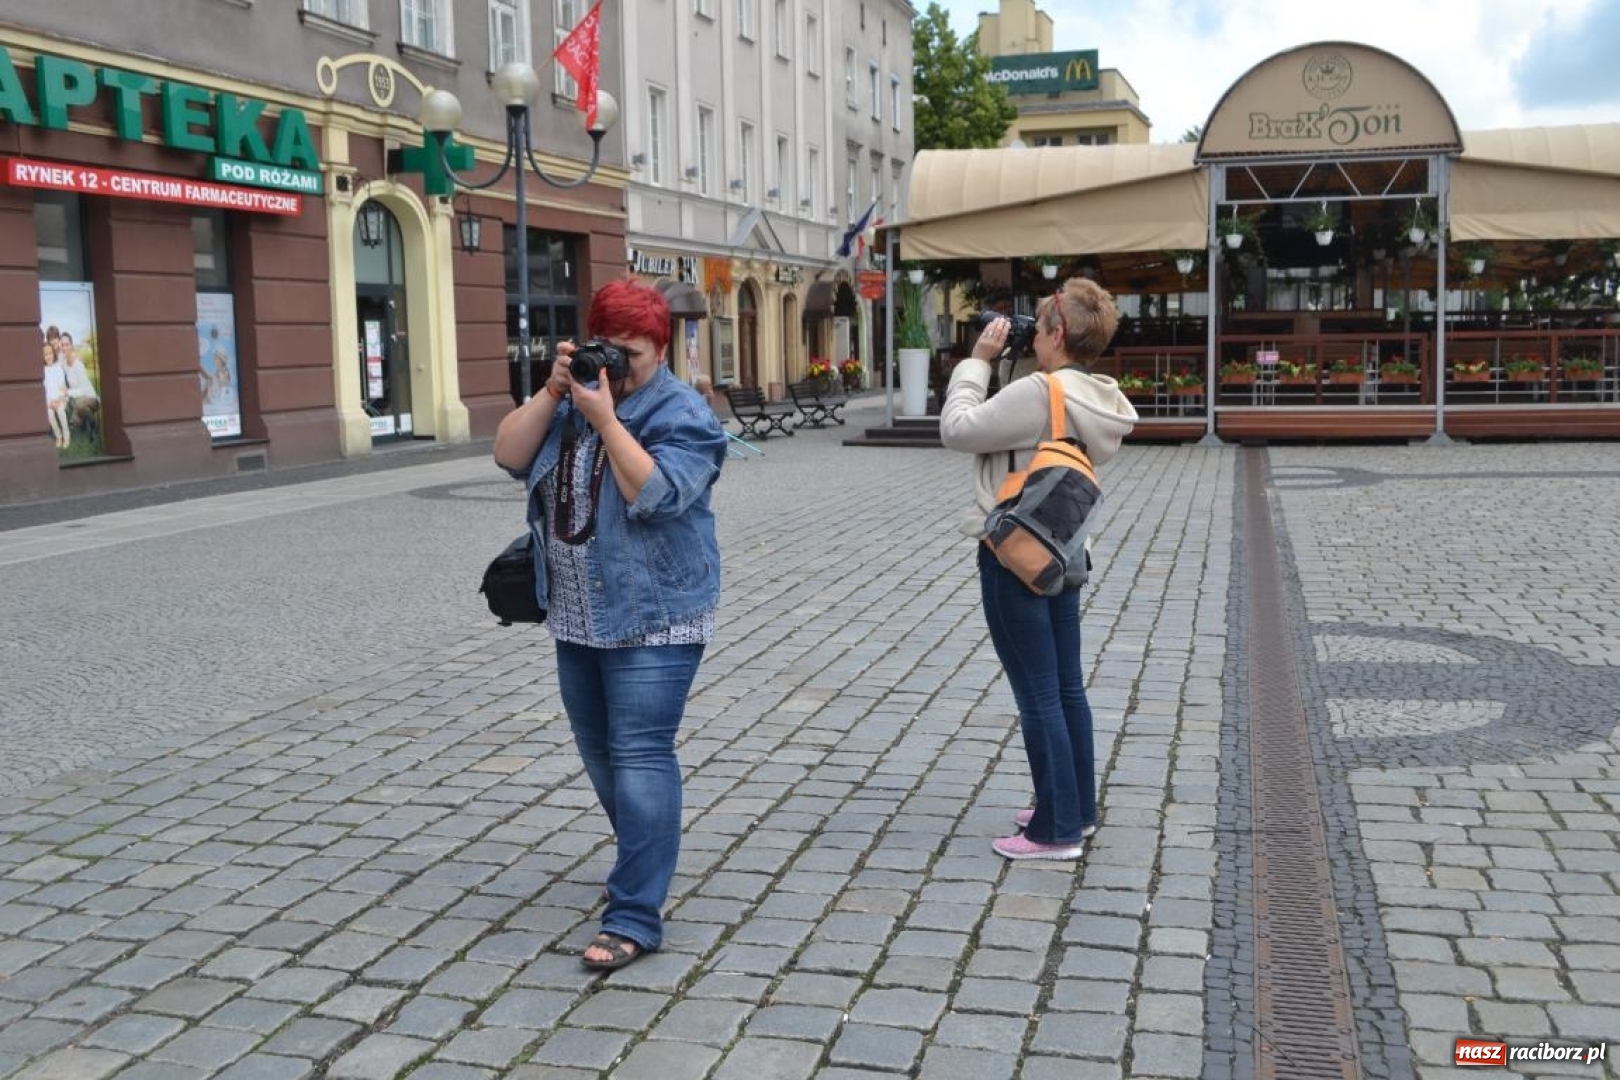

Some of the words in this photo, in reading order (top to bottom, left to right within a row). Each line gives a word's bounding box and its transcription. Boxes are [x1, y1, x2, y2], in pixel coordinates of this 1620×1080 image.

[0, 44, 320, 170] APTEKA
[15, 162, 75, 187] RYNEK
[79, 171, 98, 189] 12
[110, 175, 182, 199] CENTRUM
[185, 185, 298, 213] FARMACEUTYCZNE
[221, 162, 255, 181] POD
[260, 168, 317, 191] RÓŻAMI
